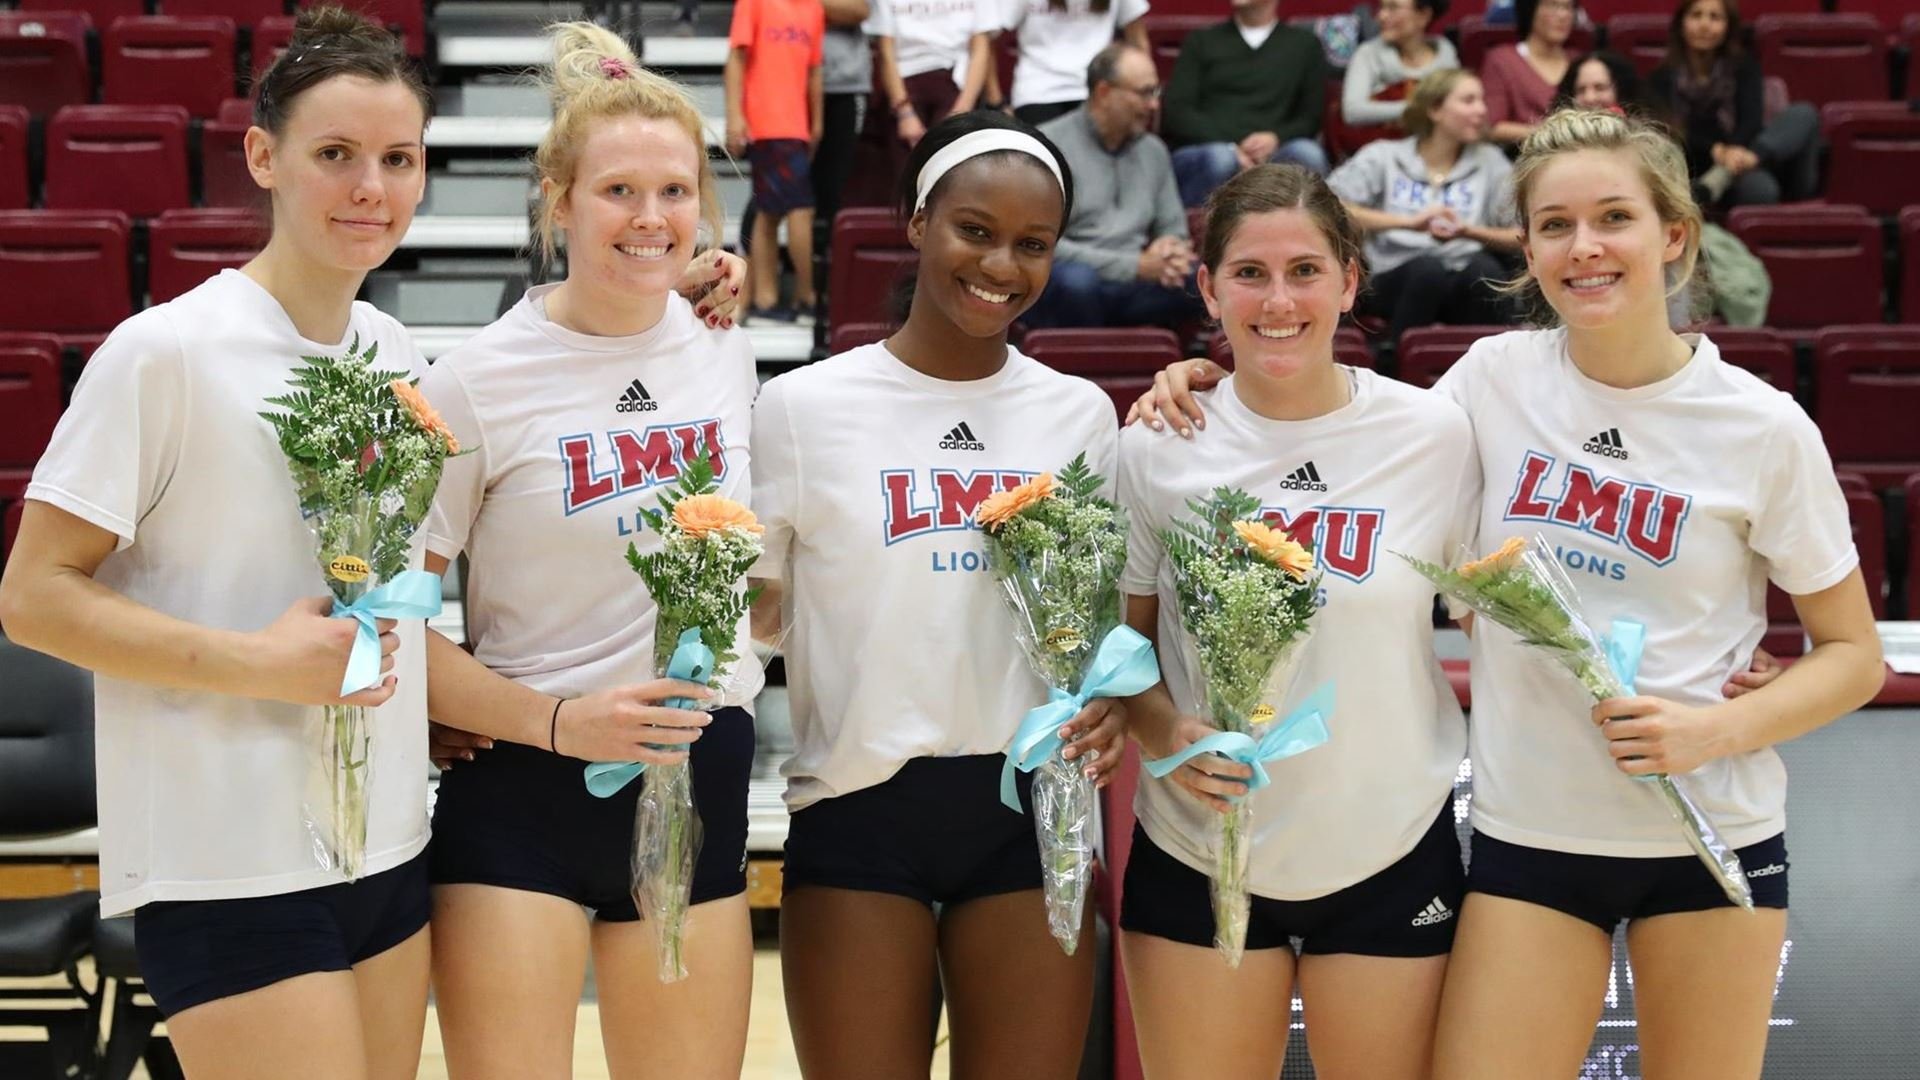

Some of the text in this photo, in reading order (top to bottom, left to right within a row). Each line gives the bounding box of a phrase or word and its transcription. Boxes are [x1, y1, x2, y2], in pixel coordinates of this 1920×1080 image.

[616, 400, 658, 413] adidas
[939, 439, 985, 451] adidas
[1583, 442, 1629, 460] adidas
[558, 417, 728, 517] LMU
[1280, 479, 1327, 492] adidas
[880, 468, 1042, 547] LM
[1503, 450, 1692, 568] LMU
